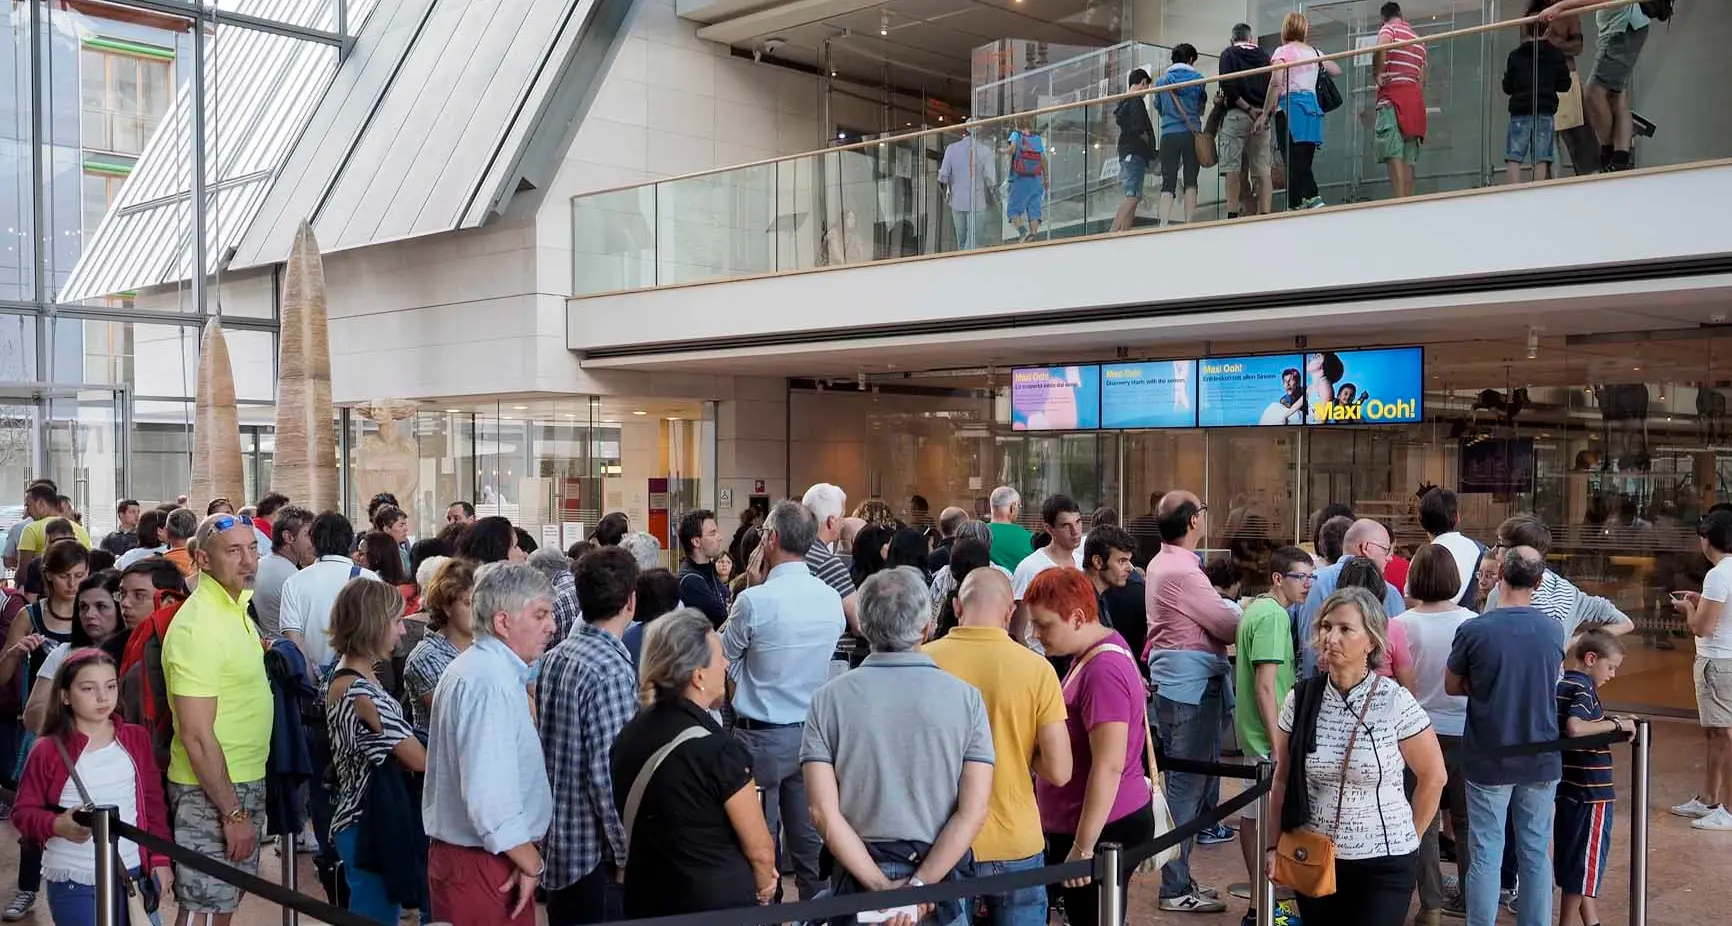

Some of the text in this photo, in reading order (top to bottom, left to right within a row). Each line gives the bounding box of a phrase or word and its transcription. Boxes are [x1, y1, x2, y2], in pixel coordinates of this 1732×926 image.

[1204, 363, 1242, 374] Maxi Ooh!
[1315, 398, 1416, 420] Maxi Ooh!
